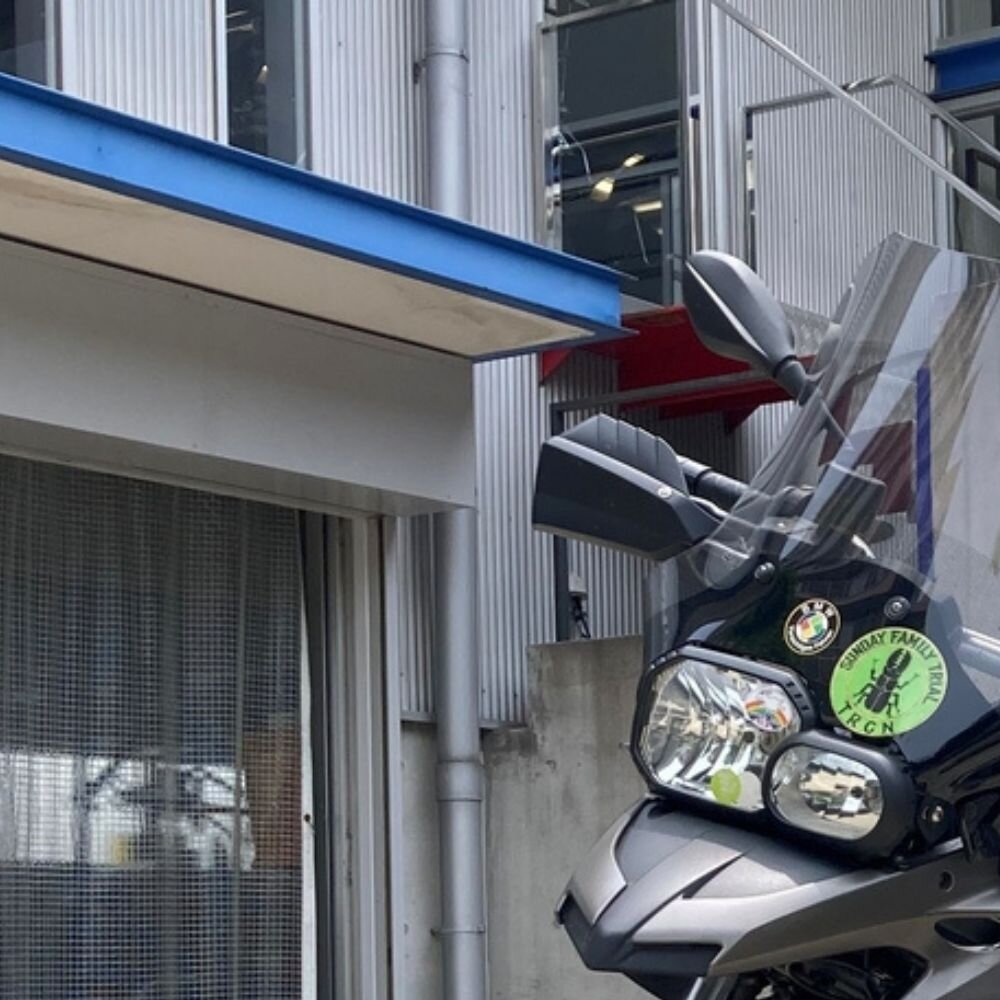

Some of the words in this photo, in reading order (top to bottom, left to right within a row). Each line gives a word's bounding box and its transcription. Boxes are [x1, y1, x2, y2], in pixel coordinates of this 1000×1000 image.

[841, 632, 886, 670] SUNDAY
[891, 631, 937, 660] FAMILY
[923, 664, 944, 704] TRIAL
[838, 700, 895, 734] TRGN
